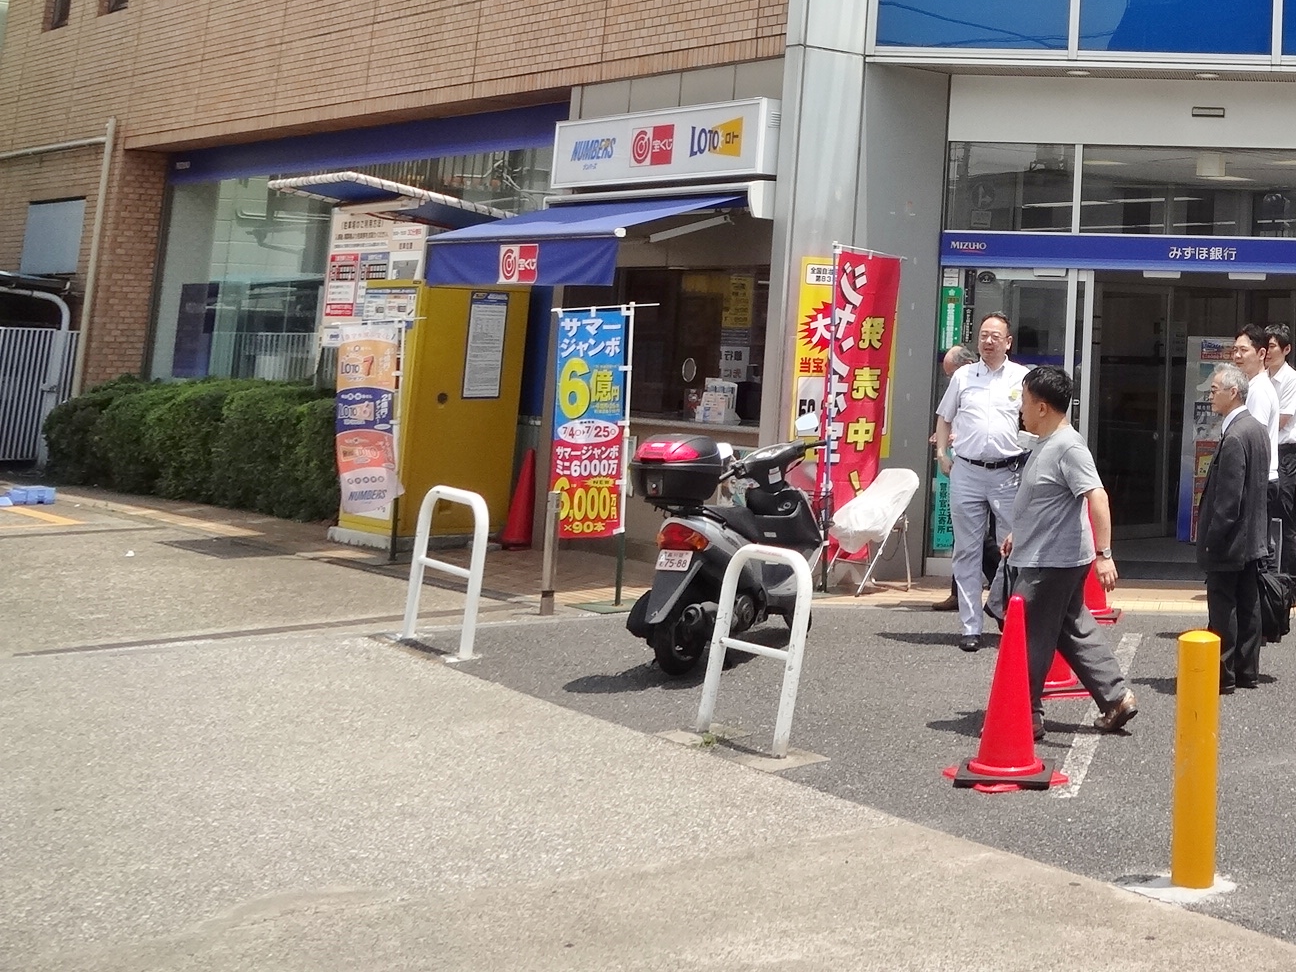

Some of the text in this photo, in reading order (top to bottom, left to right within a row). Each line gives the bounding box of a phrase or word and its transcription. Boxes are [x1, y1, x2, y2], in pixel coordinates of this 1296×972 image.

[570, 137, 617, 161] NUMBERS
[652, 138, 674, 153] 宝くじ
[689, 126, 739, 158] LOTO ロト
[951, 241, 987, 250] MIZUHO
[1168, 246, 1237, 261] みずほ銀行
[518, 258, 537, 271] 宝くじ
[561, 318, 621, 338] サマー
[560, 336, 621, 358] ジャンボ
[340, 361, 360, 374] LOTO
[363, 356, 374, 376] 7
[560, 357, 620, 419] 6億円
[338, 403, 358, 419] LOTO
[556, 445, 619, 459] サマージャンボ
[556, 459, 618, 476] ミニ6000万
[348, 489, 387, 501] NUMBERS
[937, 483, 948, 534] 警察官立寄所
[664, 559, 687, 568] 75-88
